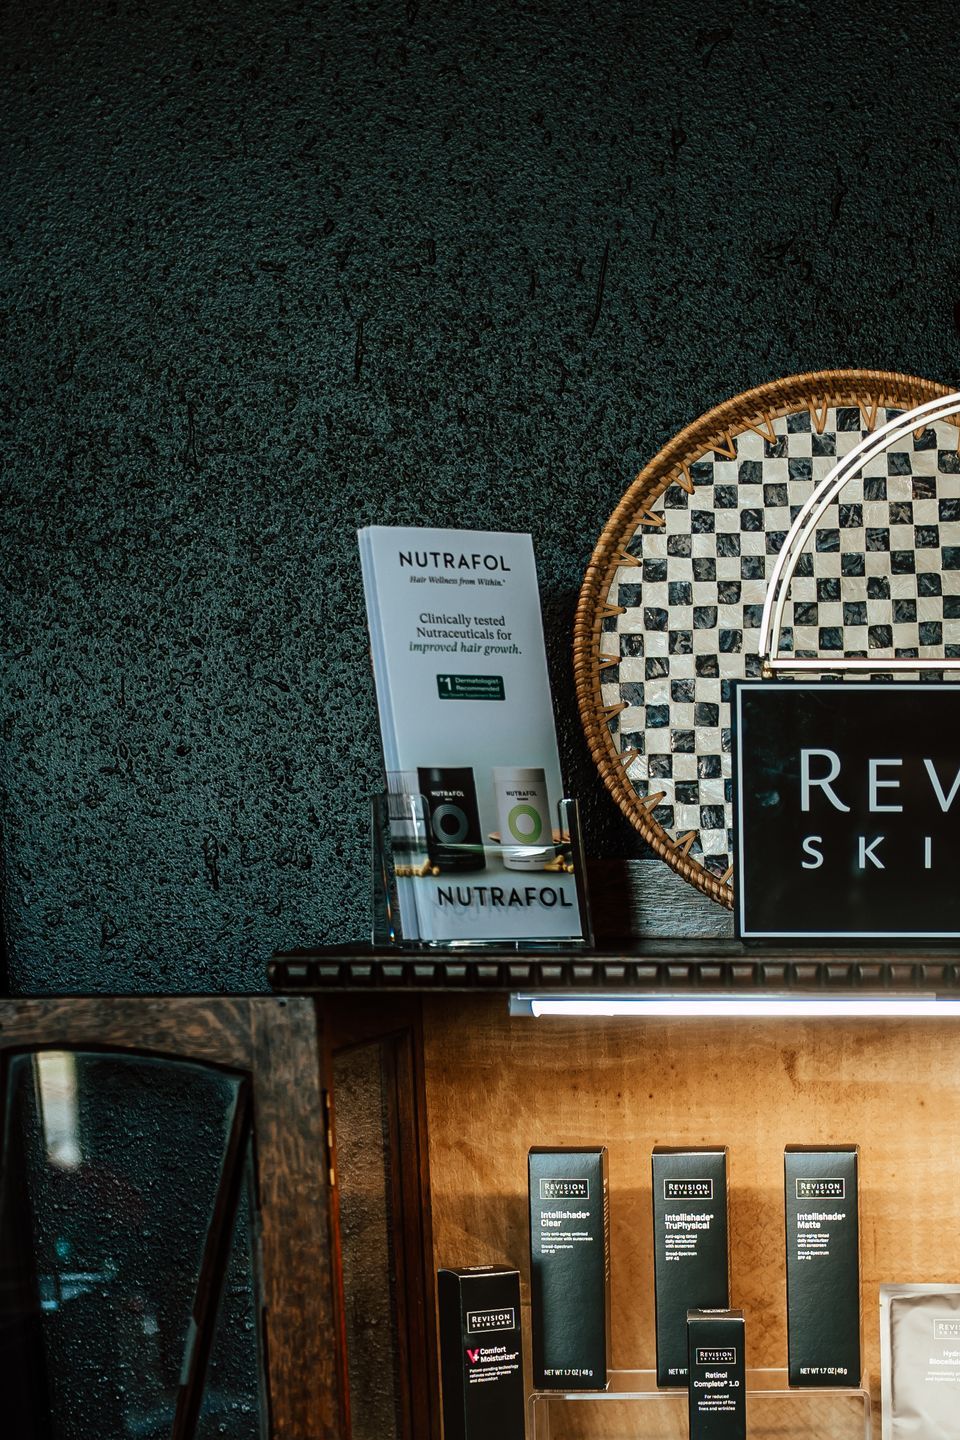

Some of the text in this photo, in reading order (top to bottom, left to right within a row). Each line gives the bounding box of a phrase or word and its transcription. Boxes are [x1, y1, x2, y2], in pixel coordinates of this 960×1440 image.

[399, 551, 511, 571] NUTRAFOL
[428, 576, 458, 585] Wellness
[458, 577, 476, 586] from
[419, 613, 506, 627] Clinically tested
[416, 627, 512, 641] Nutraceuticals for
[409, 642, 522, 656] improved hair growth.
[455, 677, 499, 685] Dermatologist
[431, 790, 464, 798] NUTRAFOL
[437, 886, 573, 907] NUTRAFOL
[540, 1219, 562, 1227] Clear
[665, 1222, 709, 1230] TruPhysical
[472, 1313, 510, 1323] REVISION
[480, 1346, 506, 1355] Comfort
